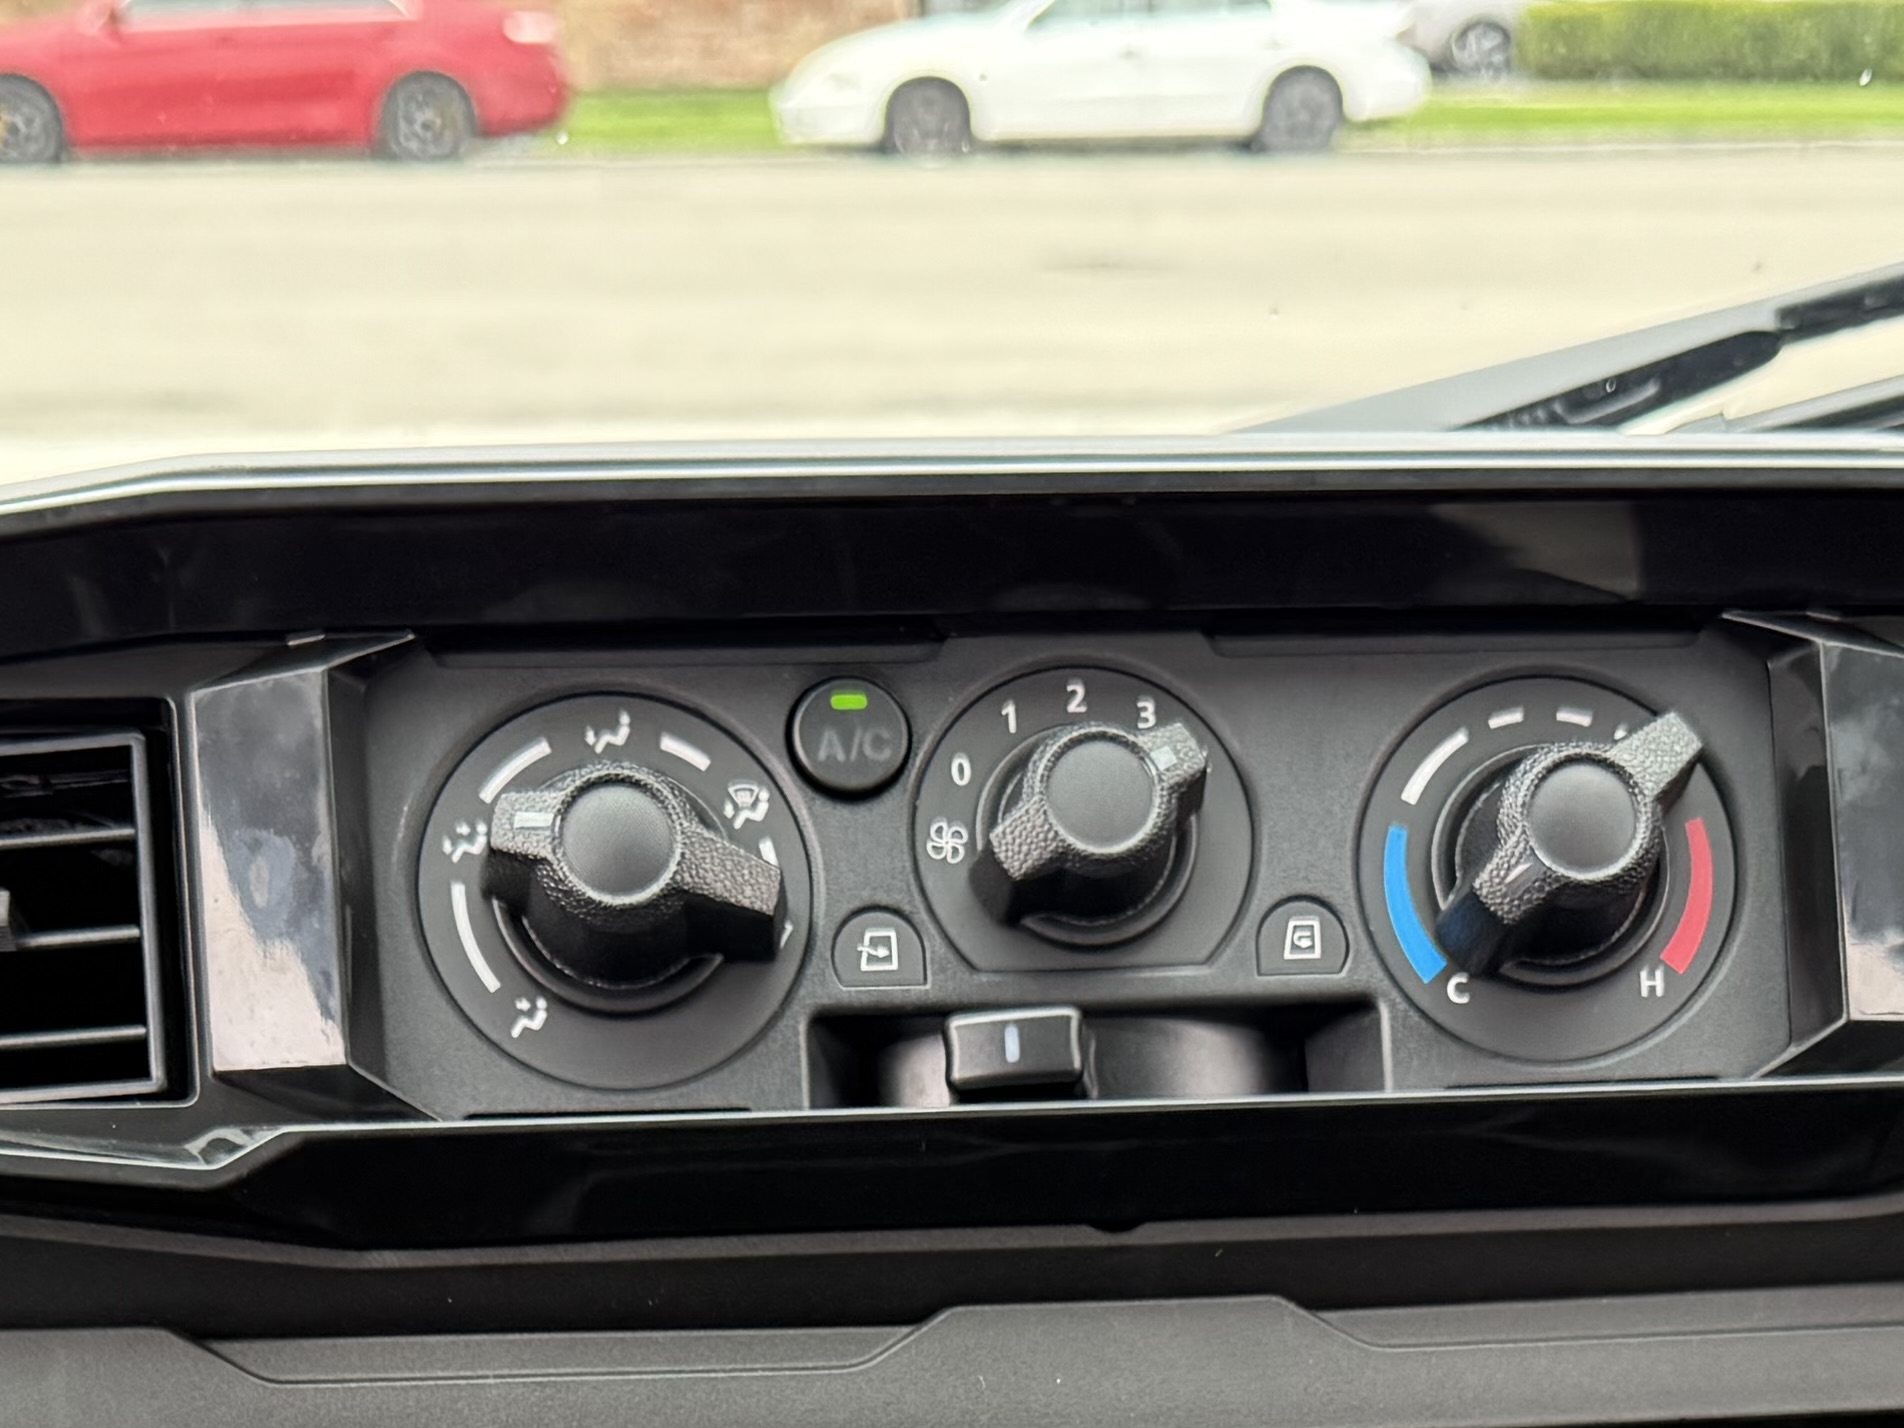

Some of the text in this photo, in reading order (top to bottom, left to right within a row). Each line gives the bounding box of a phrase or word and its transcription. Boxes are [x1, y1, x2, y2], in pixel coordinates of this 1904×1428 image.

[1001, 681, 1156, 734] 1 2 3
[817, 727, 892, 763] A/C
[951, 753, 972, 786] 0
[1446, 972, 1471, 1005] C
[1639, 966, 1665, 998] H
